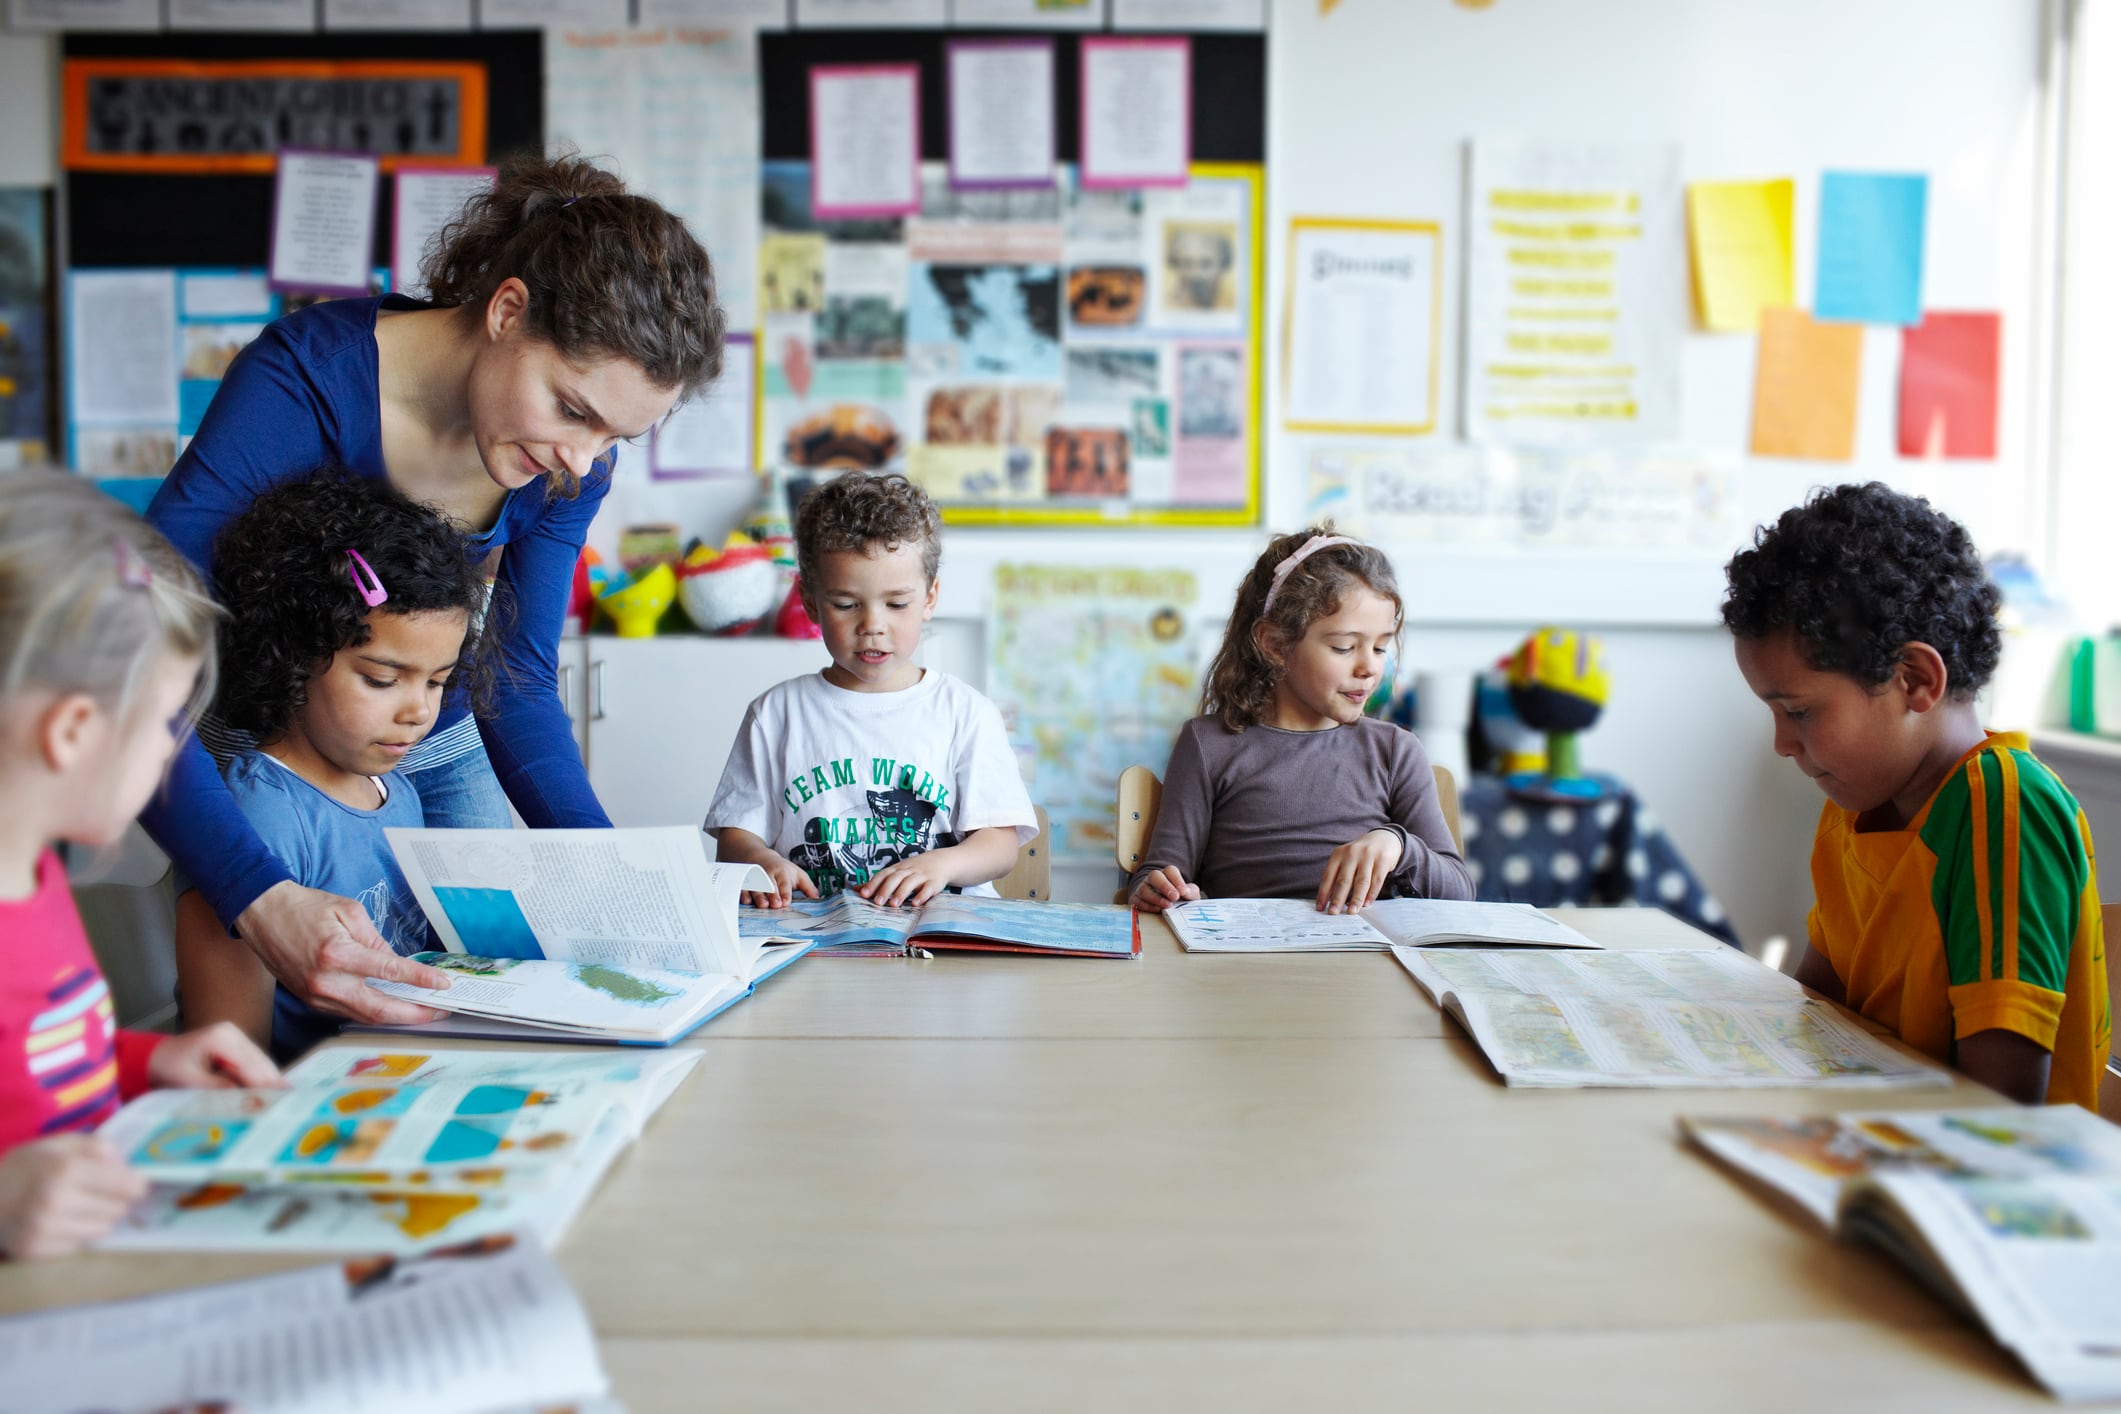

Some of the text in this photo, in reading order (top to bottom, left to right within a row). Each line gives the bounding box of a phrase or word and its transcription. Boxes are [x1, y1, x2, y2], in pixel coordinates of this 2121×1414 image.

[784, 758, 950, 814] TEAM WORK
[818, 817, 917, 845] MAKES
